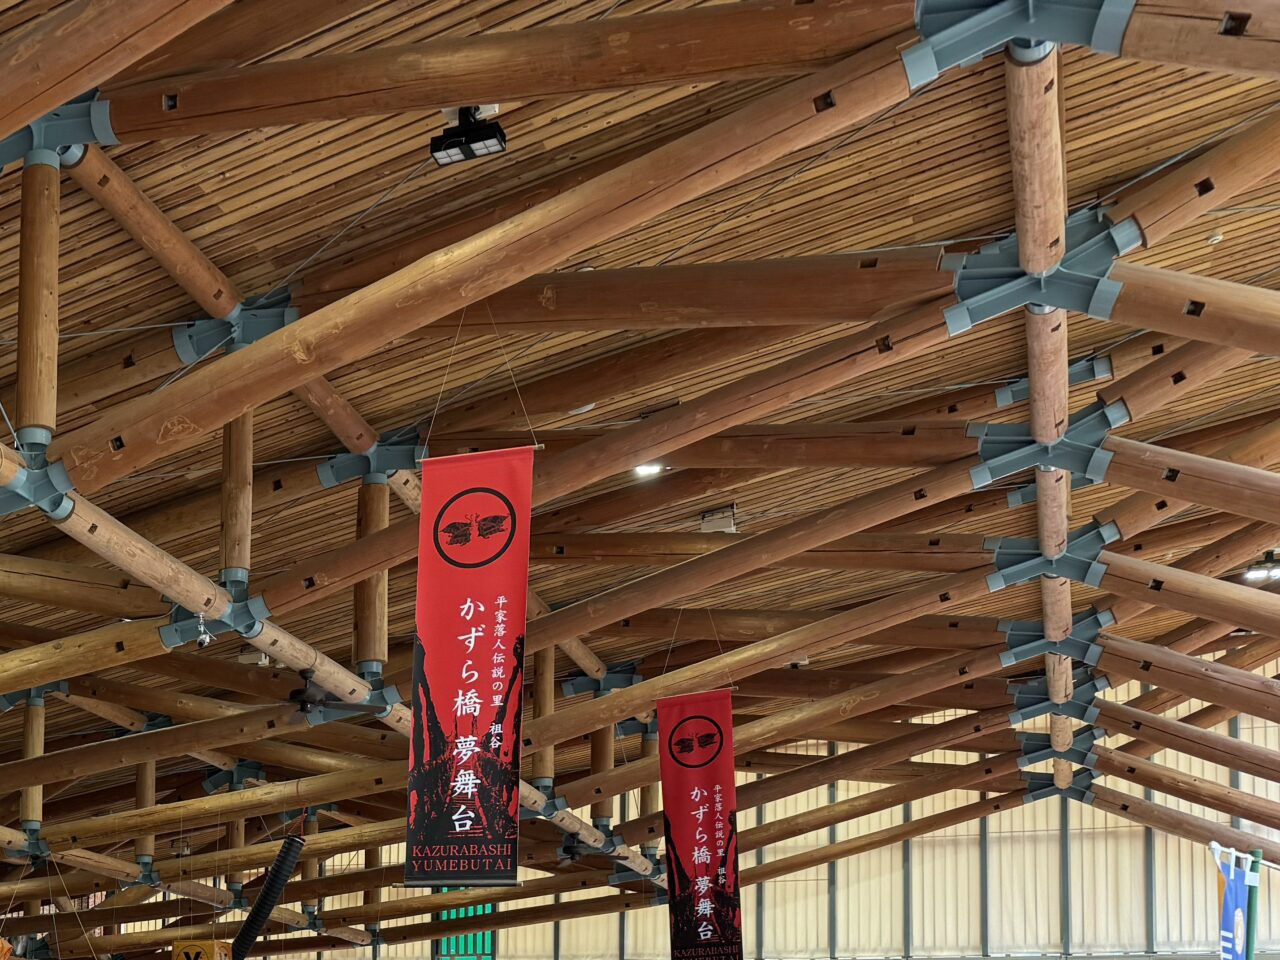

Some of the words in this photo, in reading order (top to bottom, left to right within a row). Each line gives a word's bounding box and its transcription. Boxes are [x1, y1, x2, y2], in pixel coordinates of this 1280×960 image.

[453, 597, 485, 717] かずら橋
[490, 595, 507, 707] 平家落人伝説の里
[489, 722, 503, 749] 祖谷
[451, 735, 481, 832] 夢舞台
[412, 844, 512, 858] KAZURABASHI
[690, 786, 712, 865] かずら橋
[412, 858, 512, 871] YUMEBUTAI
[695, 876, 715, 940] 夢舞台
[673, 945, 739, 957] KAZURABASHI
